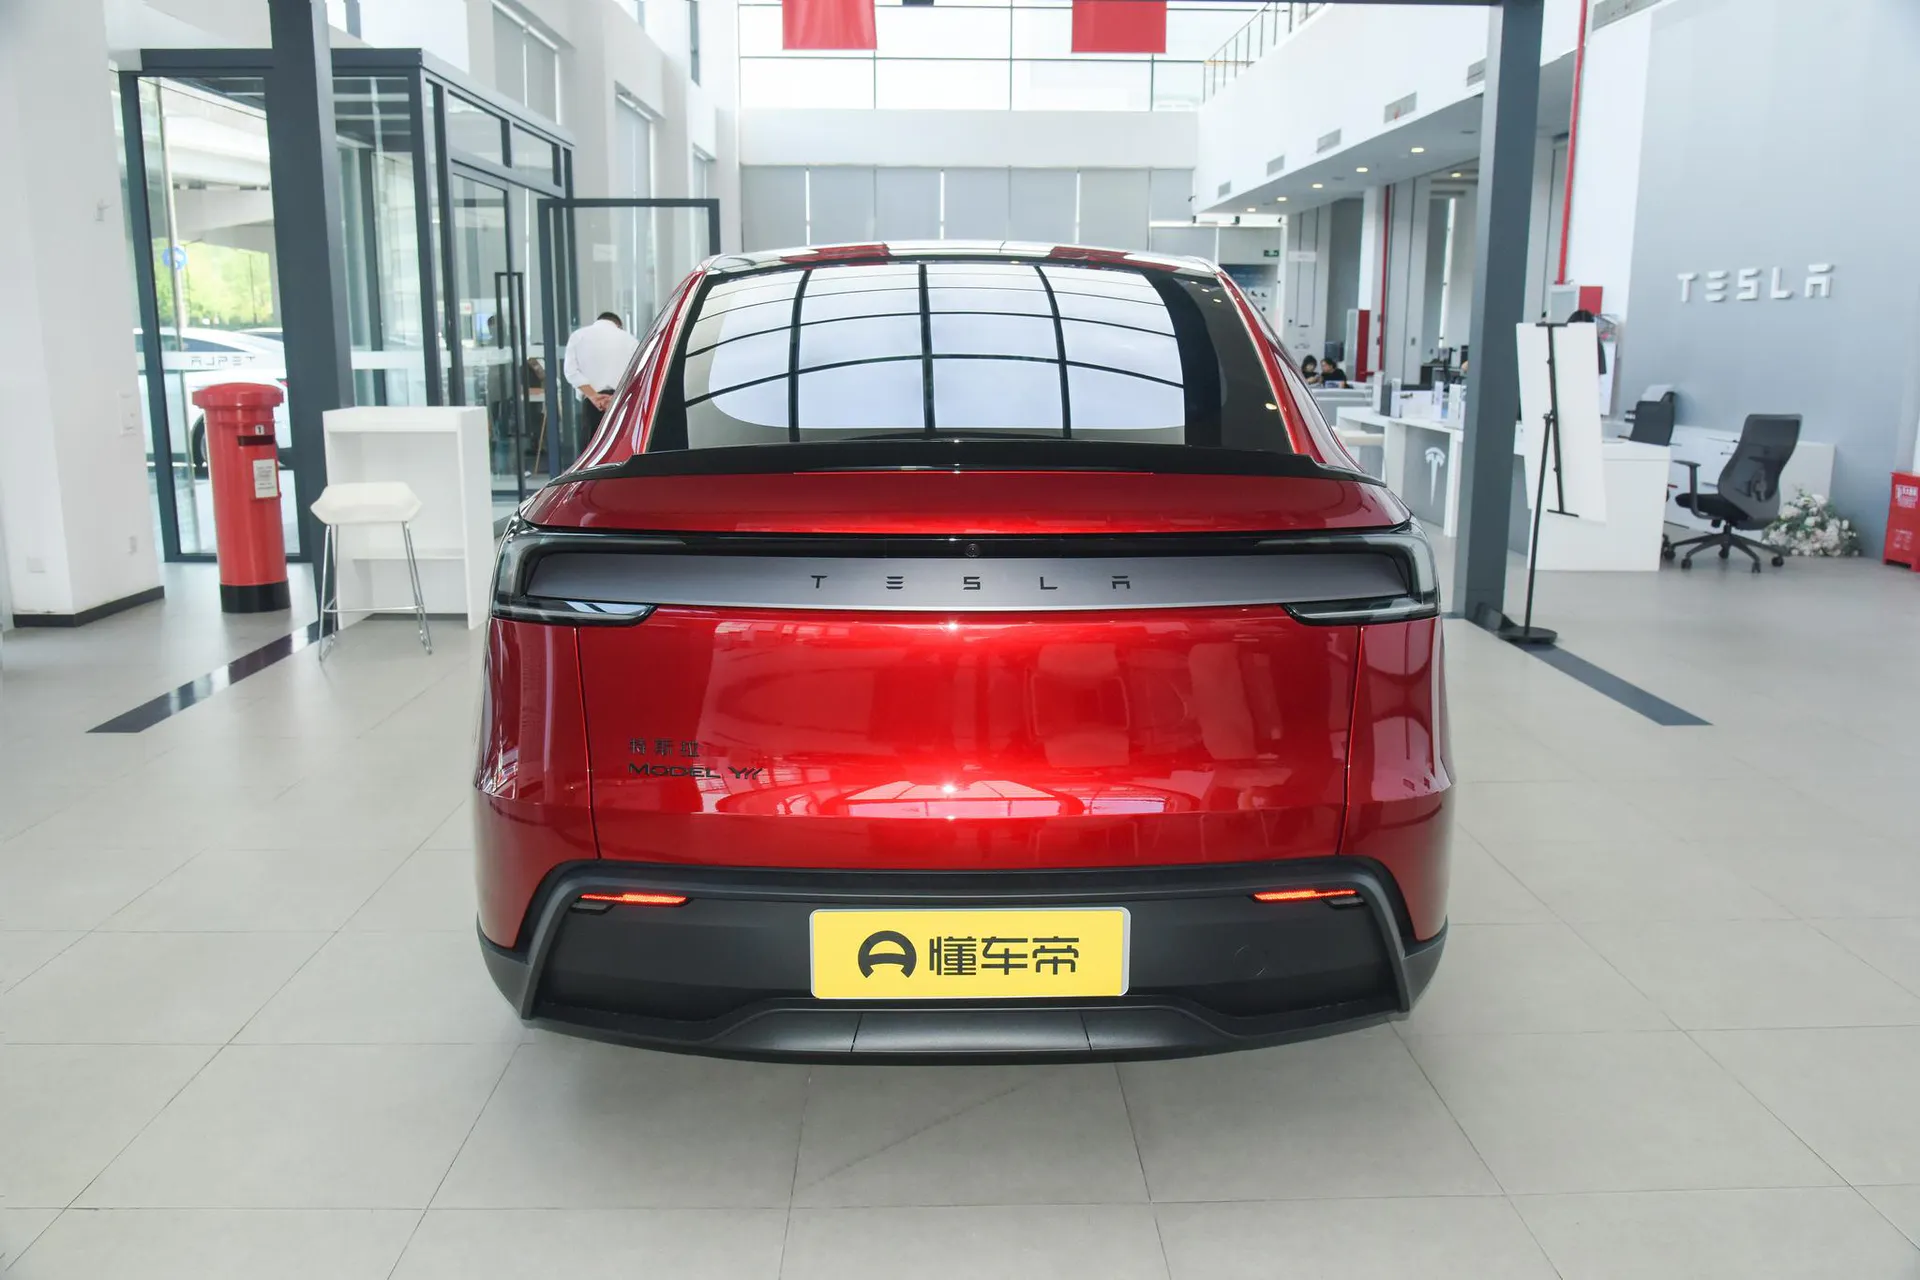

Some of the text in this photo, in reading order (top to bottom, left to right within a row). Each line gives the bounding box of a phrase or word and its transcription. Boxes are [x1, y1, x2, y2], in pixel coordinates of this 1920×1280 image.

[1677, 263, 1834, 302] TESLA
[811, 575, 1131, 590] TESLA
[629, 738, 699, 757] 特斯拉
[929, 936, 1080, 976] 懂车帝
